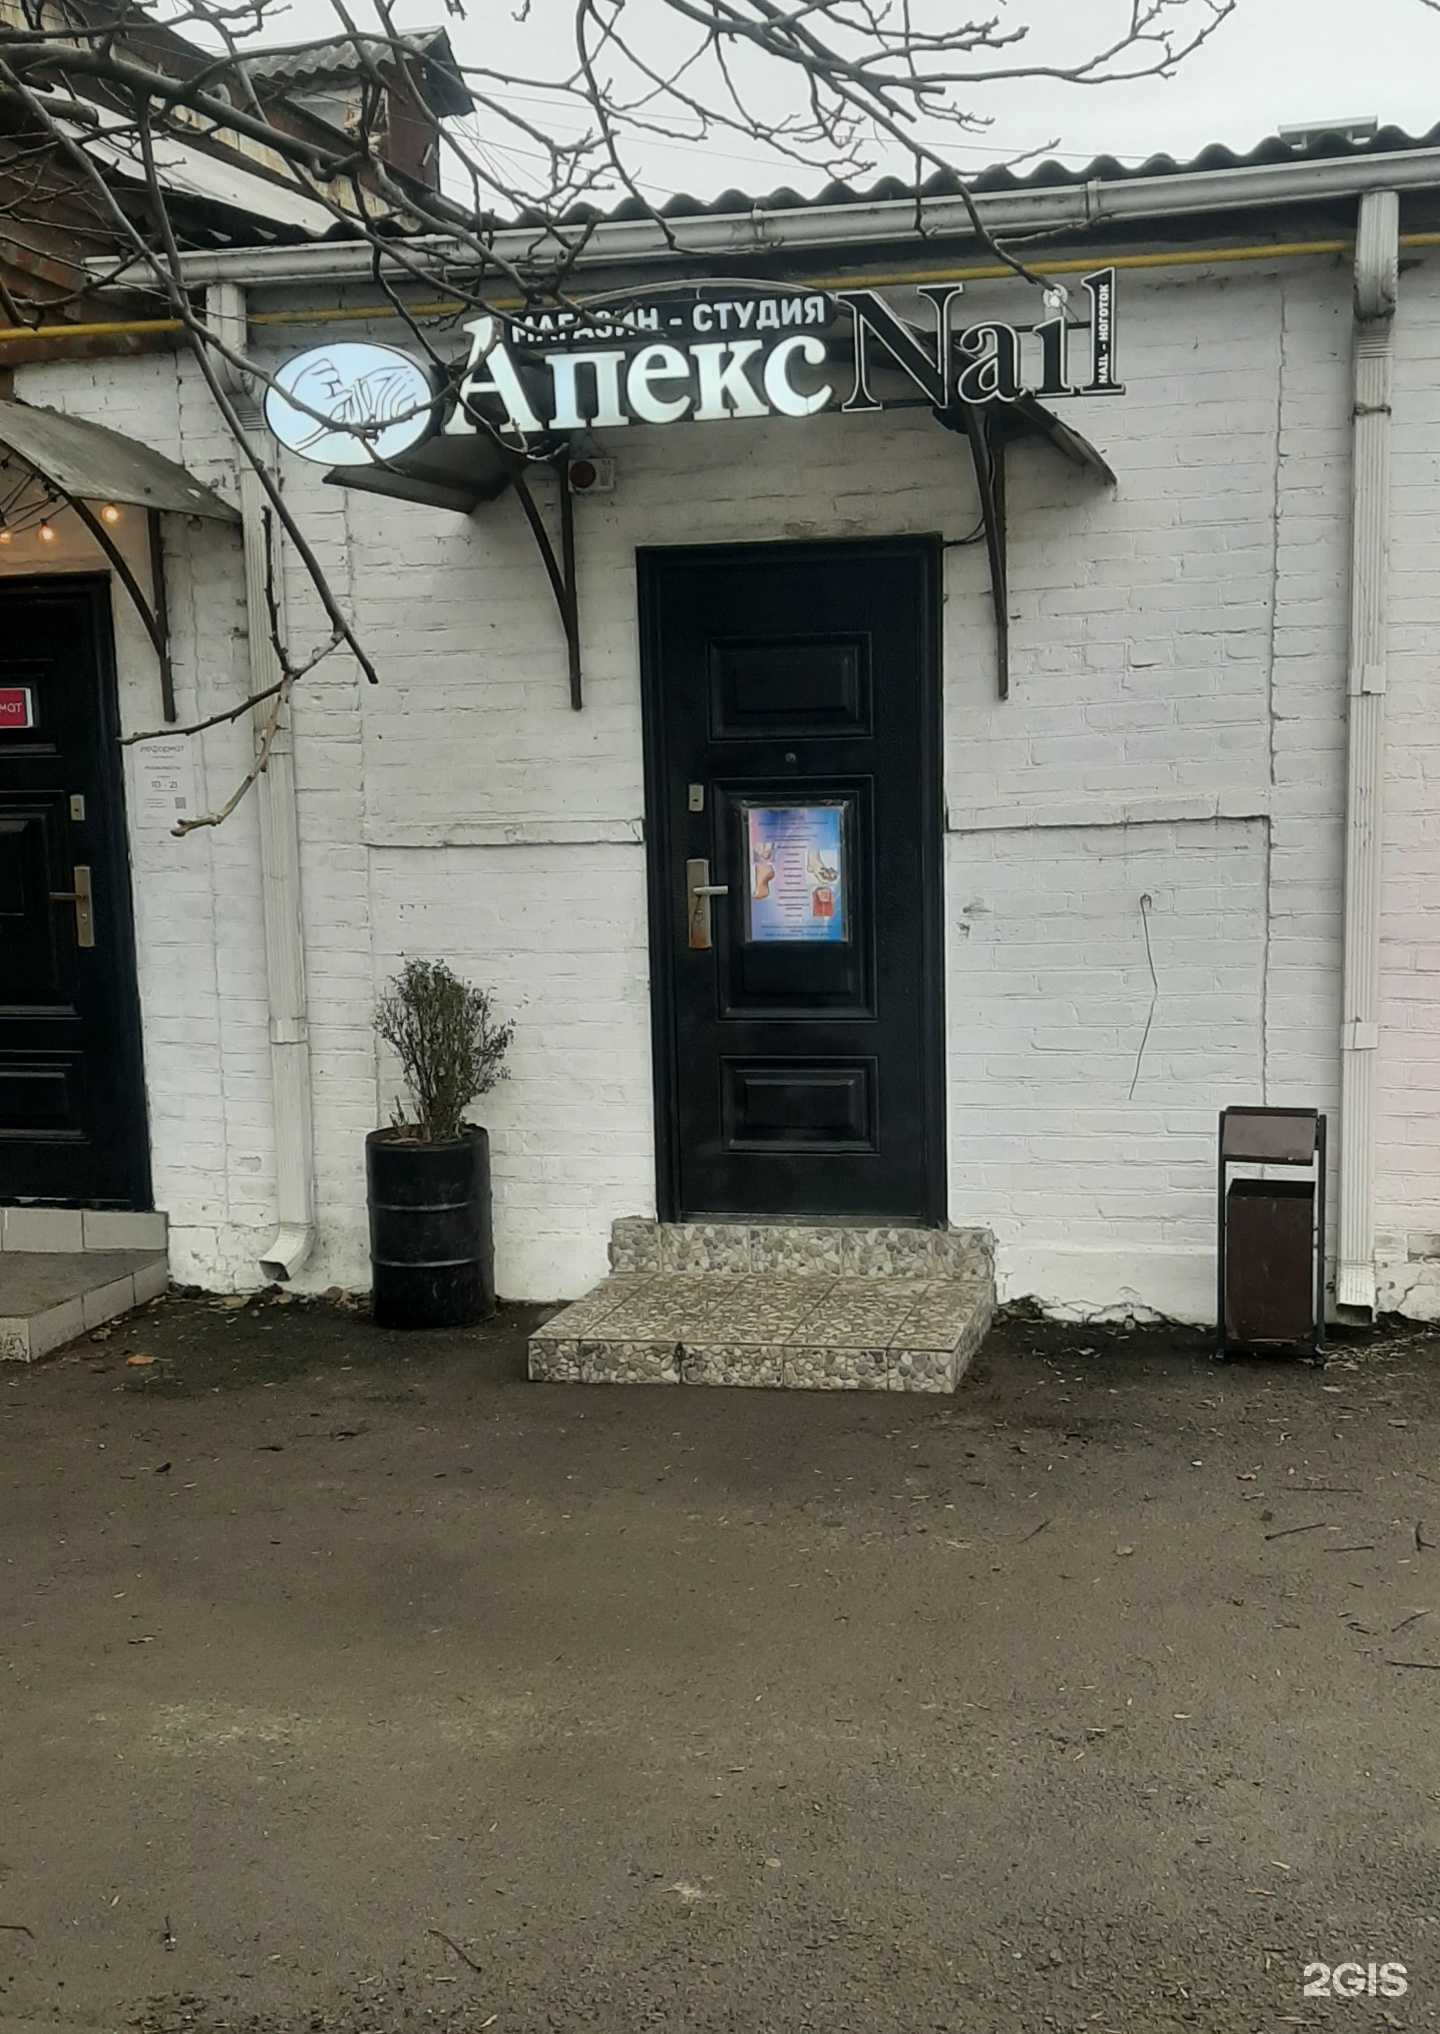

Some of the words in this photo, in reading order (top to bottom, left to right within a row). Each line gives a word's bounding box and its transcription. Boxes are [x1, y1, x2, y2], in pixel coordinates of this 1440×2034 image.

[692, 296, 826, 331] СТУДИЯ
[1098, 283, 1110, 341] НОГОТОК
[444, 316, 833, 435] Апекс
[835, 267, 1126, 413] Nail
[1098, 353, 1109, 384] NAIL
